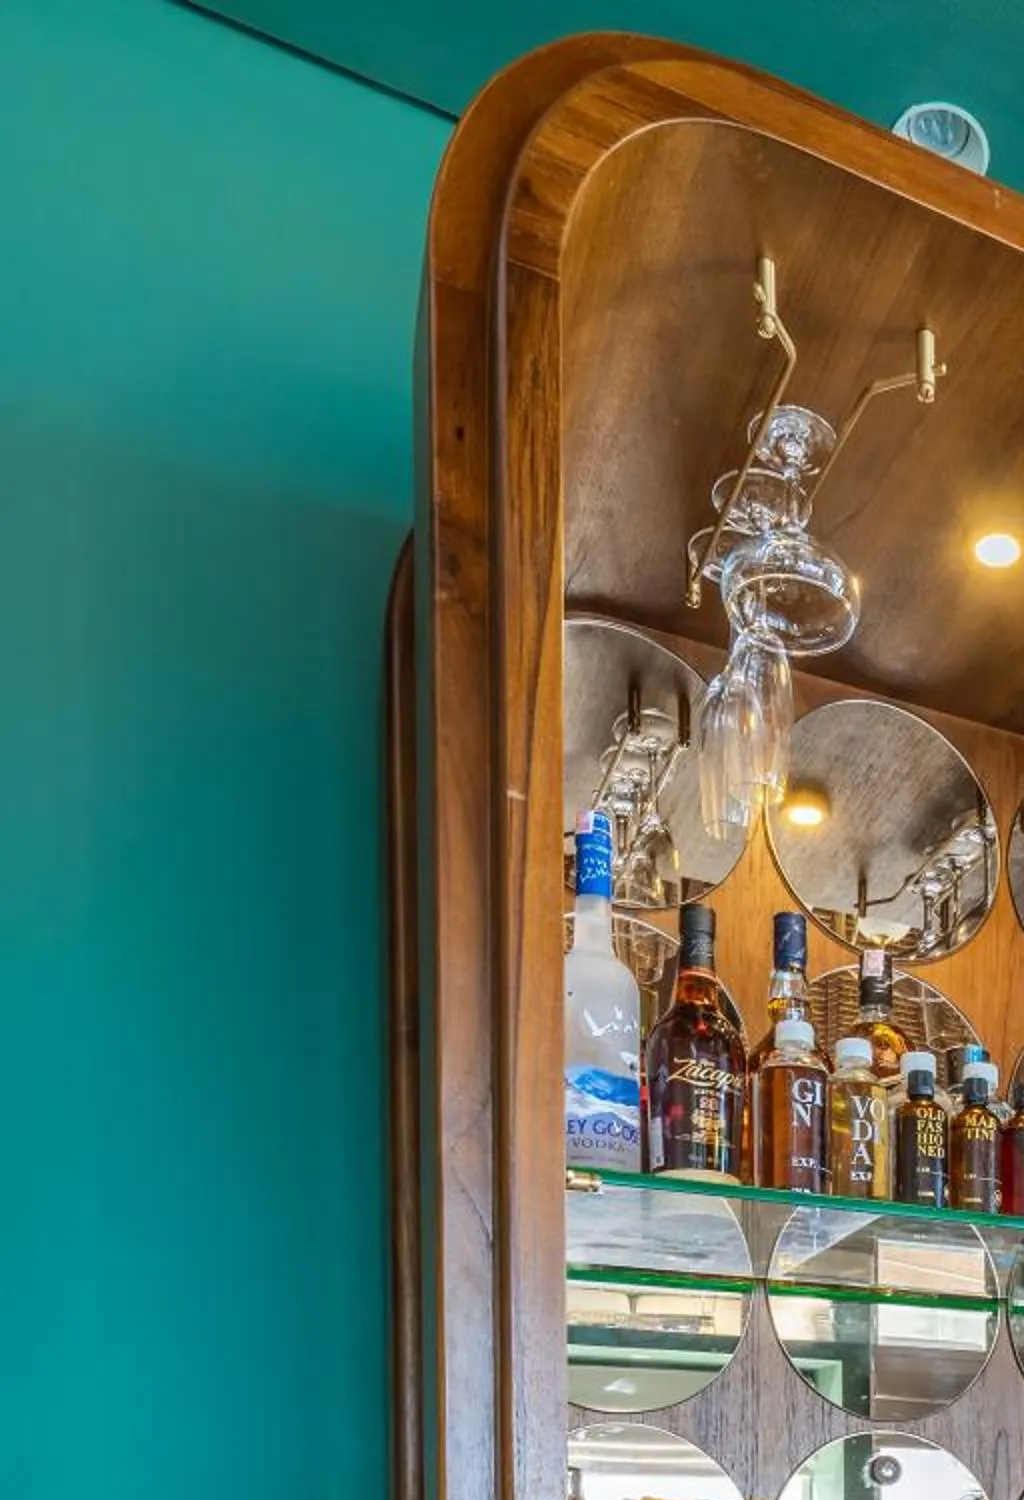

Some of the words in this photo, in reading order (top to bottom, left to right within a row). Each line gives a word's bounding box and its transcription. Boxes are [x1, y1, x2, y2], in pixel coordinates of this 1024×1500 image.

[916, 1107, 946, 1121] OLD
[567, 1118, 588, 1135] EY
[916, 1119, 943, 1133] FAS
[916, 1144, 946, 1159] NED
